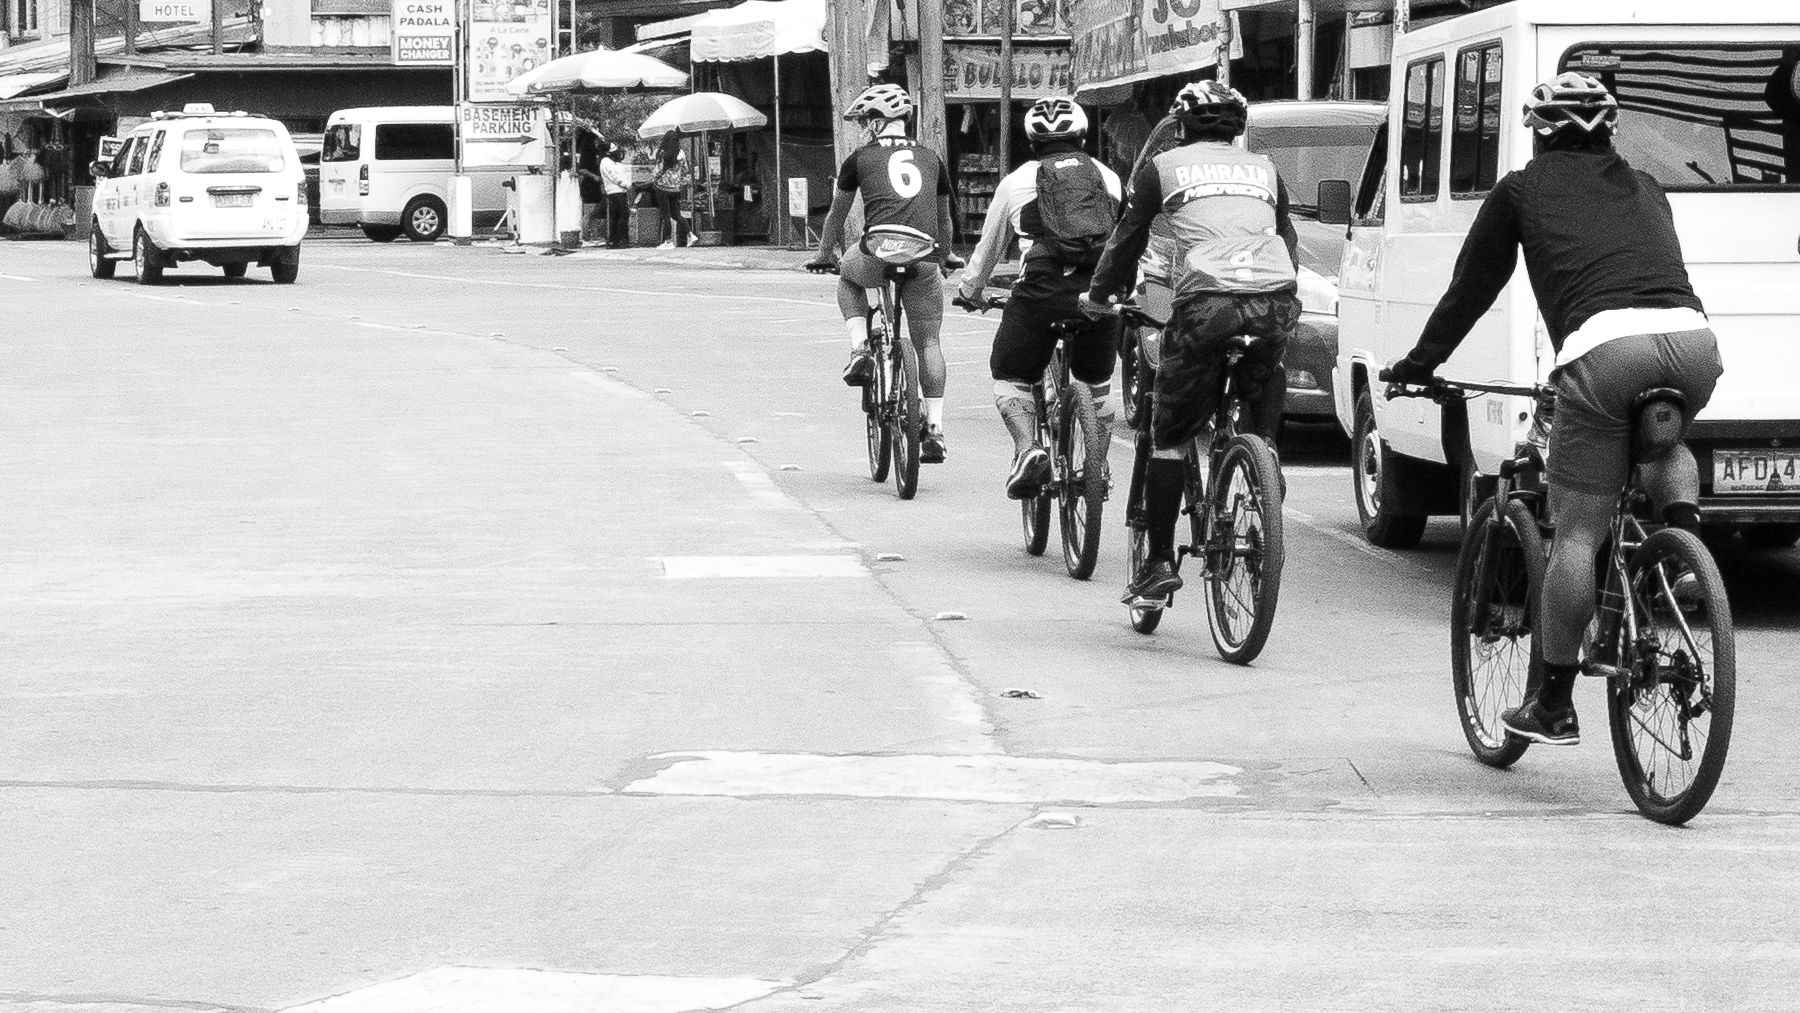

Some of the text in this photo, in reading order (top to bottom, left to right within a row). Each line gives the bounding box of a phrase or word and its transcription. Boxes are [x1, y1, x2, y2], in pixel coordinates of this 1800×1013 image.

[154, 5, 195, 17] HOTEL
[406, 4, 443, 14] CASH
[400, 17, 450, 26] PADALA
[400, 37, 450, 49] MONEY
[400, 49, 450, 60] CHANGER
[963, 61, 1042, 89] BULLO
[463, 107, 538, 122] BASEMENT
[472, 121, 532, 134] PARKING
[887, 149, 923, 199] 6
[1175, 163, 1269, 186] BAHRAIN
